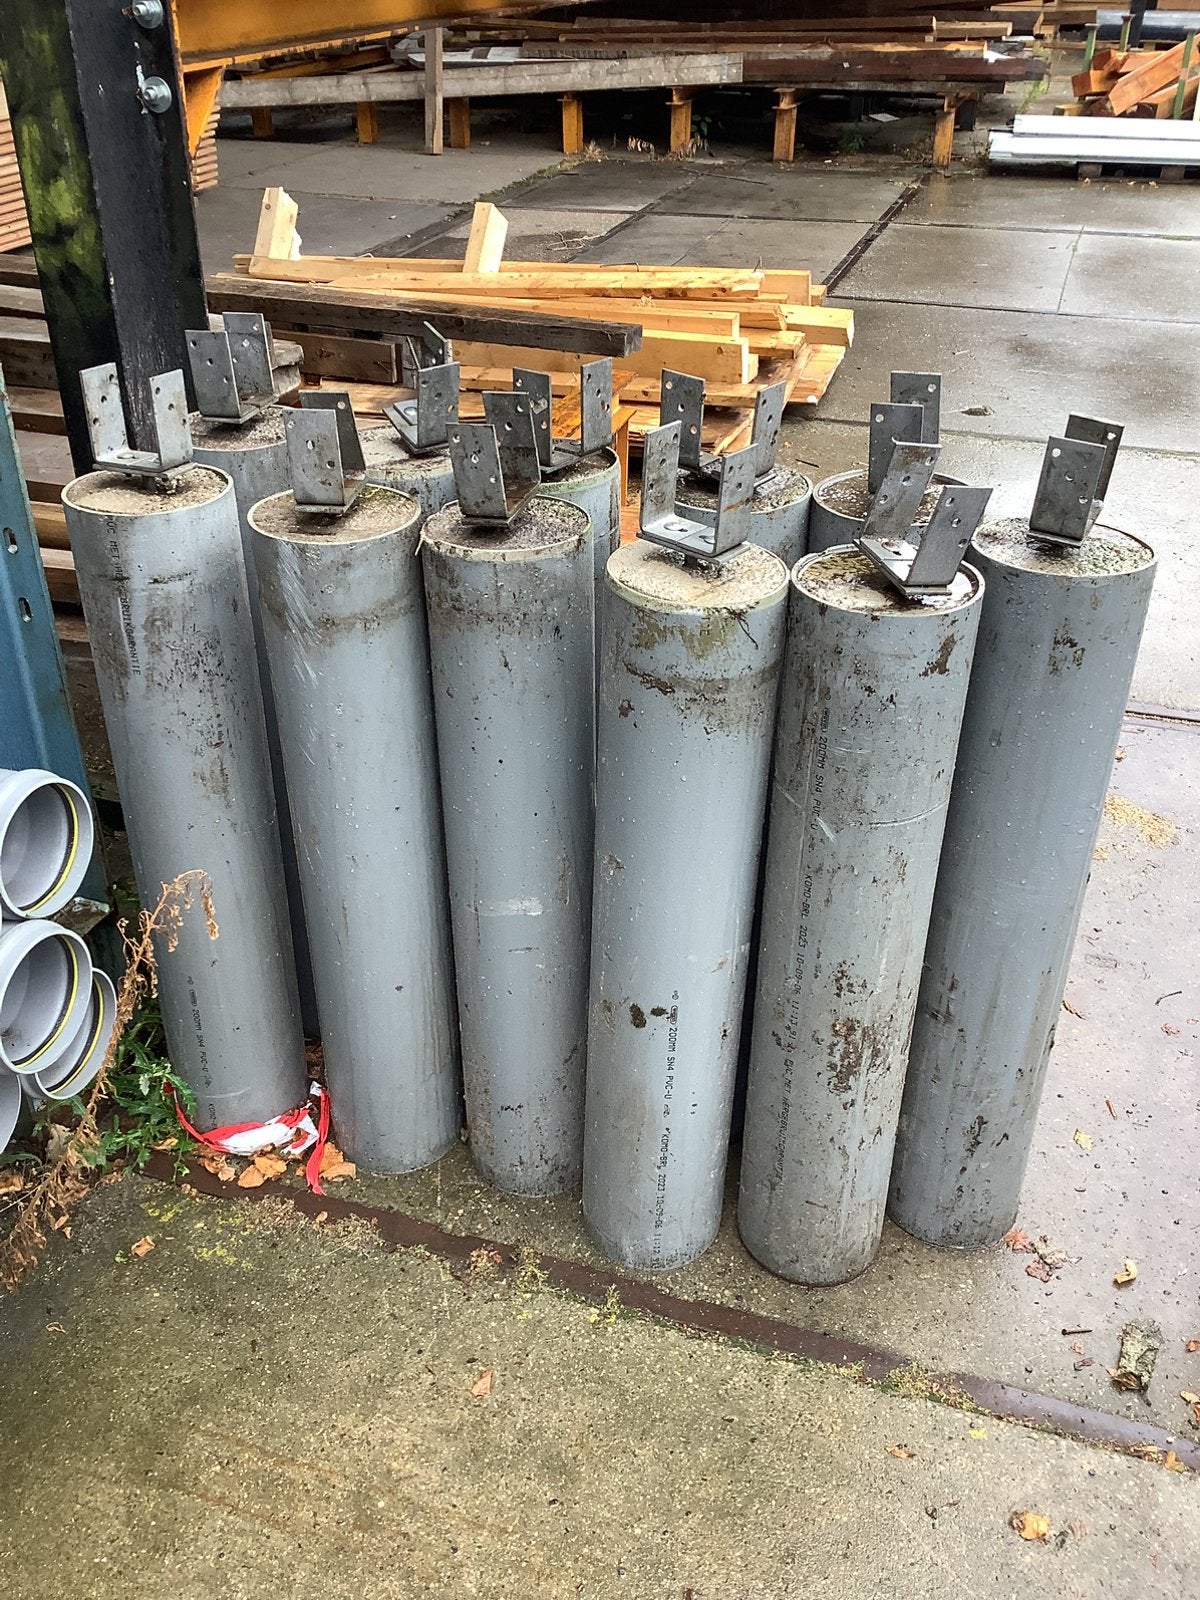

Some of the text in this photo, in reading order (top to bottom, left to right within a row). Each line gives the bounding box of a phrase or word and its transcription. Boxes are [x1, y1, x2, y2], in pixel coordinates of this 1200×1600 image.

[109, 540, 120, 560] MET
[816, 736, 828, 769] 200MM
[814, 774, 824, 793] SN4
[801, 874, 813, 919] KOMO-BRL
[798, 925, 808, 948] 2023
[793, 953, 805, 995] 10-09-06
[191, 1009, 202, 1031] 200MM
[199, 1051, 209, 1073] PVC-U
[668, 1027, 678, 1052] 200MM
[666, 1056, 676, 1071] SN4
[664, 1075, 674, 1100] PVC-U
[657, 1174, 666, 1192] 2023
[654, 1196, 665, 1229] 10-09-06
